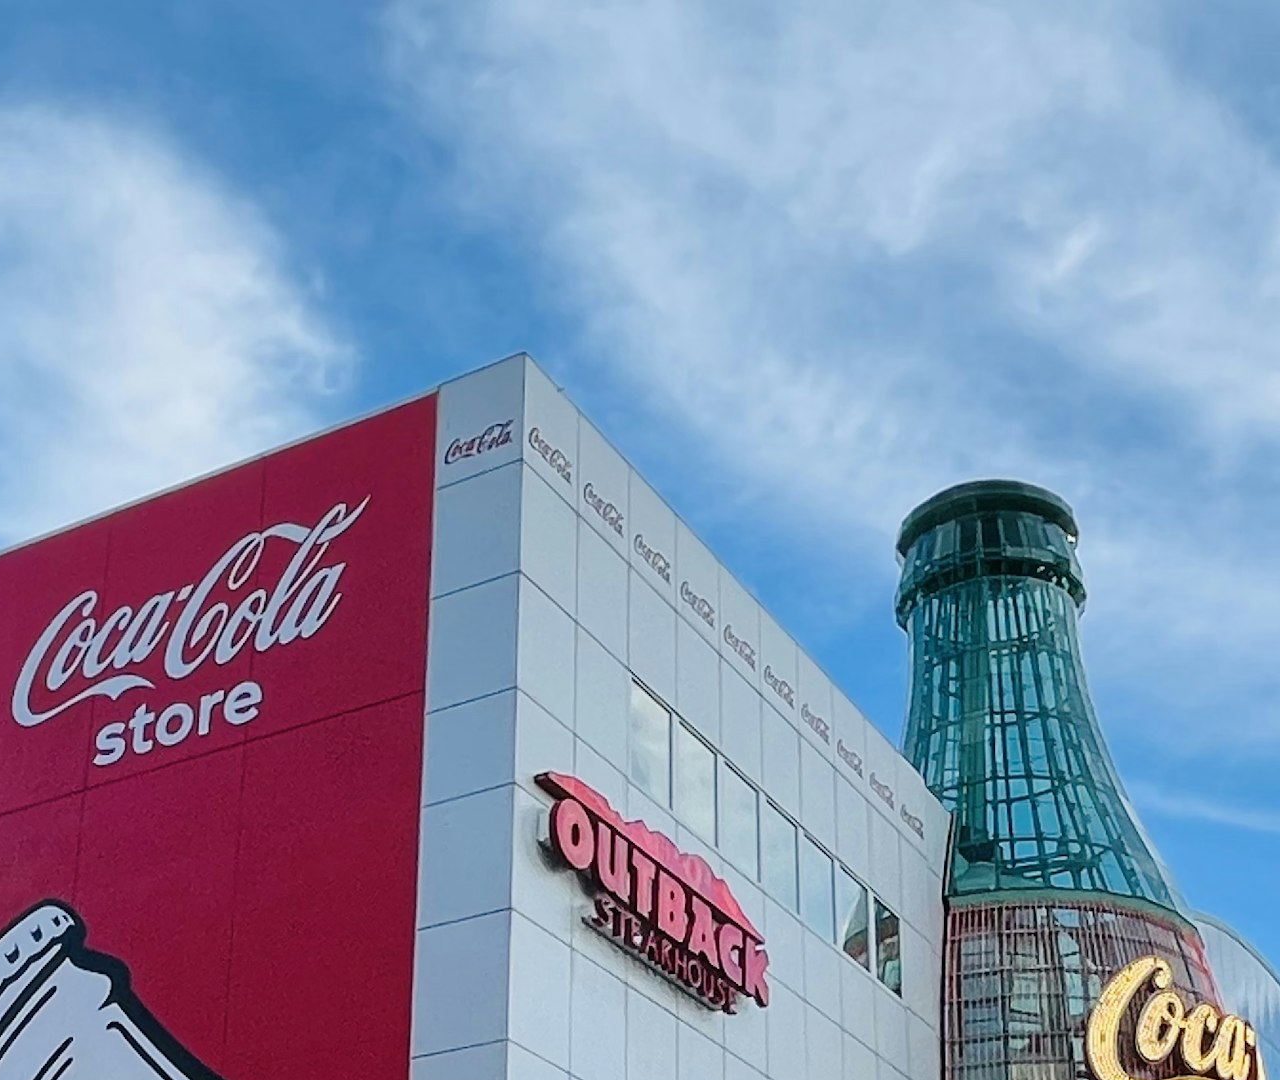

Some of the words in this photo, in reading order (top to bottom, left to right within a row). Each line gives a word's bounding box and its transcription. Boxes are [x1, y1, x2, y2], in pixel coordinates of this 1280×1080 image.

[91, 680, 264, 766] store
[550, 797, 770, 1008] OUTBACK
[591, 896, 738, 1015] STEAKHOUSE
